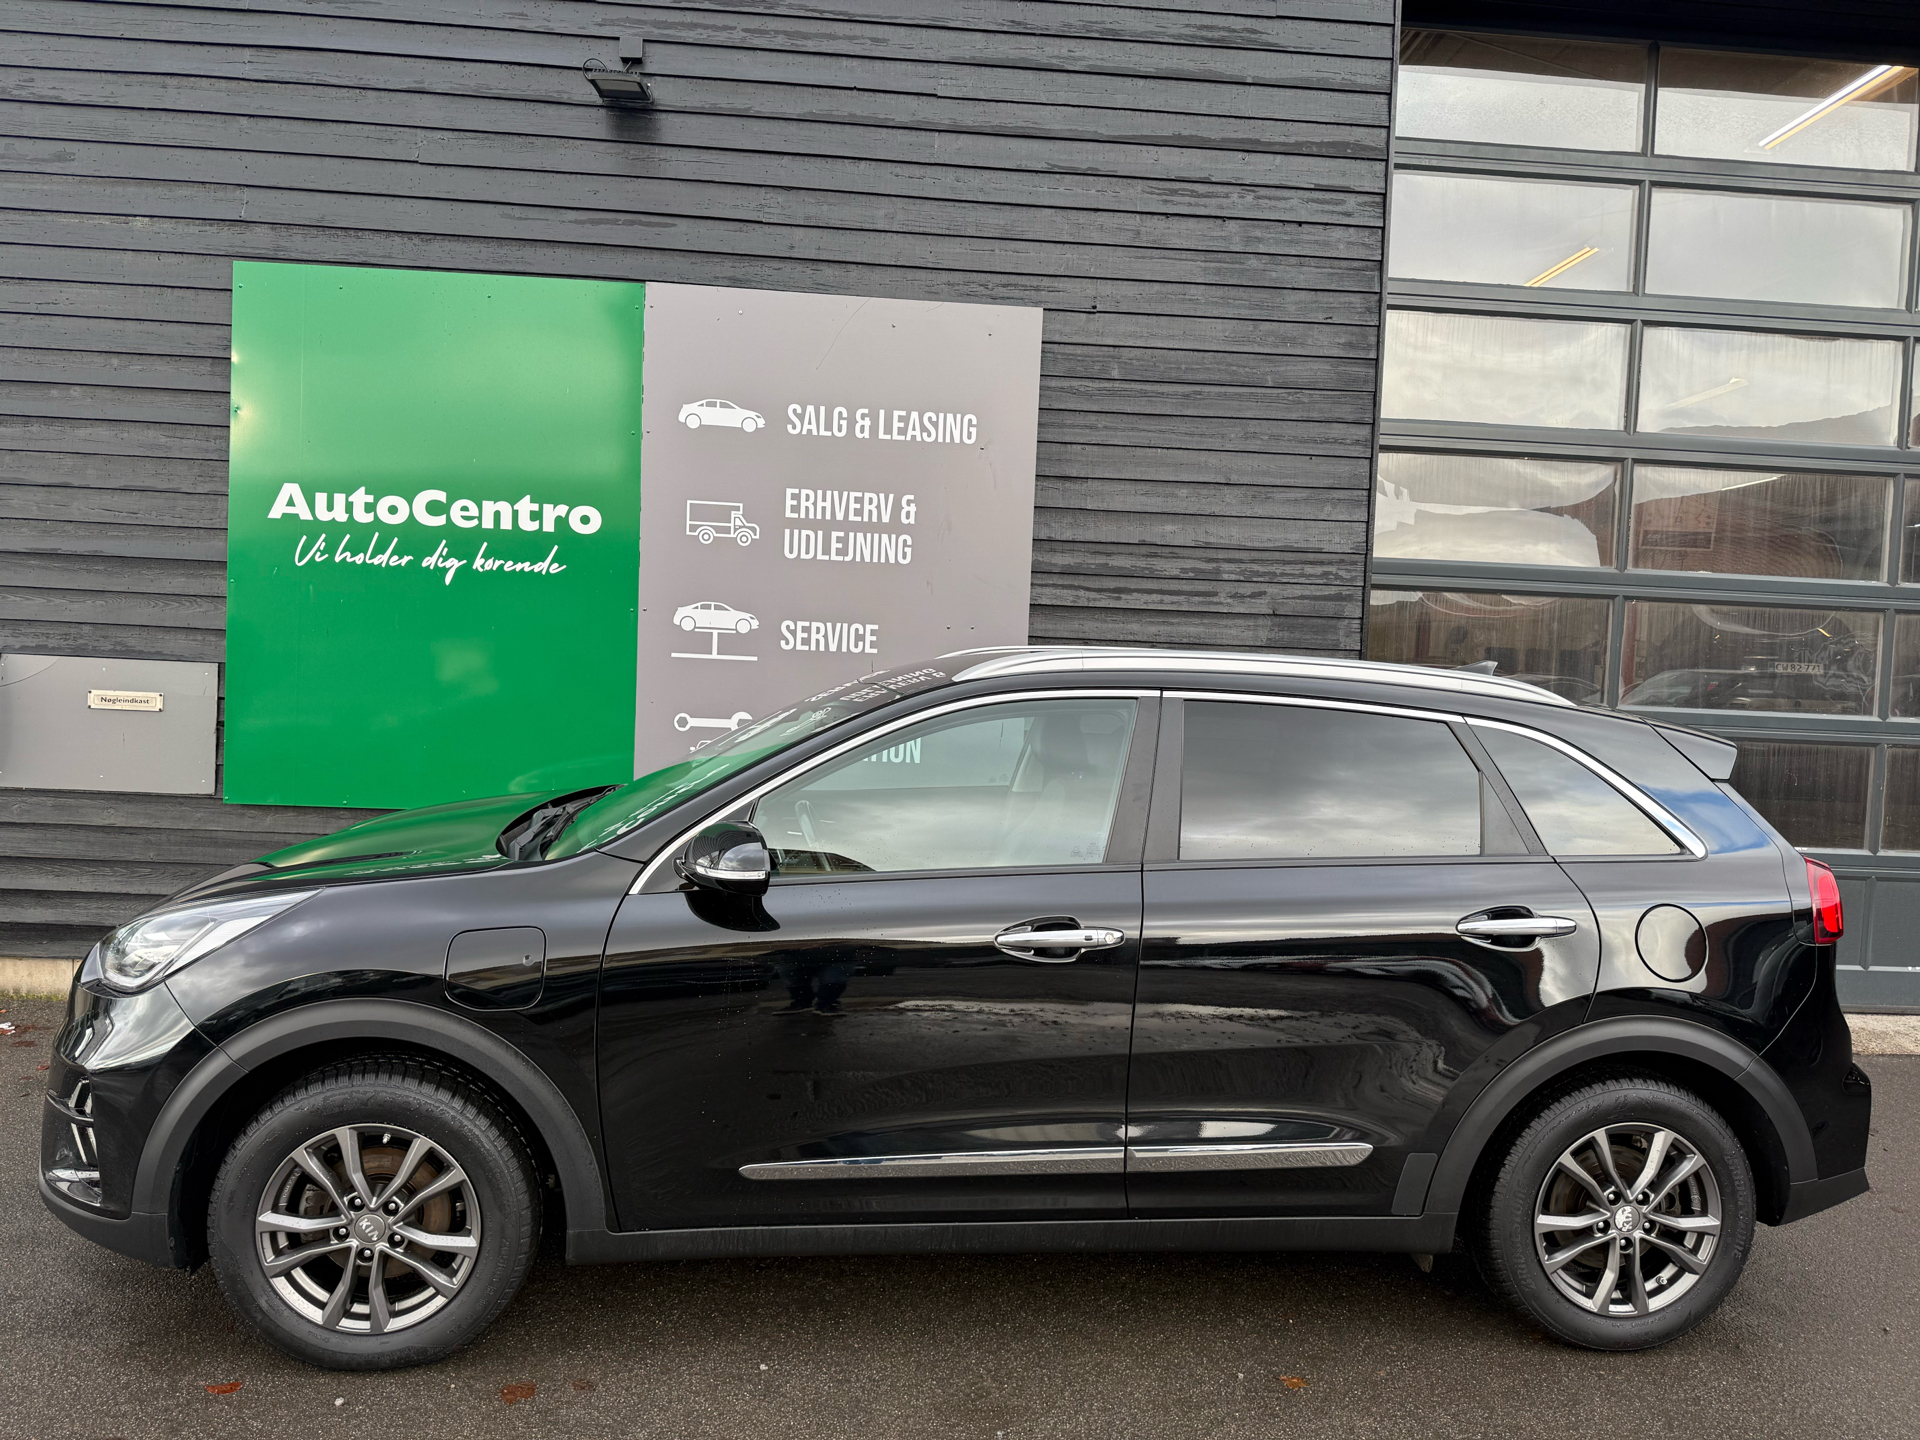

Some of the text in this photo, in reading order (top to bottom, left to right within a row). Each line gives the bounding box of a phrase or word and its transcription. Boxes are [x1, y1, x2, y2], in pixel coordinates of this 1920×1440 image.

[786, 403, 978, 445] SALG & LEASING
[267, 482, 602, 535] AutoCentro
[785, 487, 917, 525] ERHVERV &
[294, 531, 567, 586] Vi holder dig kørende
[783, 528, 912, 565] UDLEJNING
[780, 620, 879, 654] SERVICE
[1790, 664, 1802, 672] 82
[100, 696, 150, 705] Nøgleindkast
[359, 1218, 380, 1241] KIA
